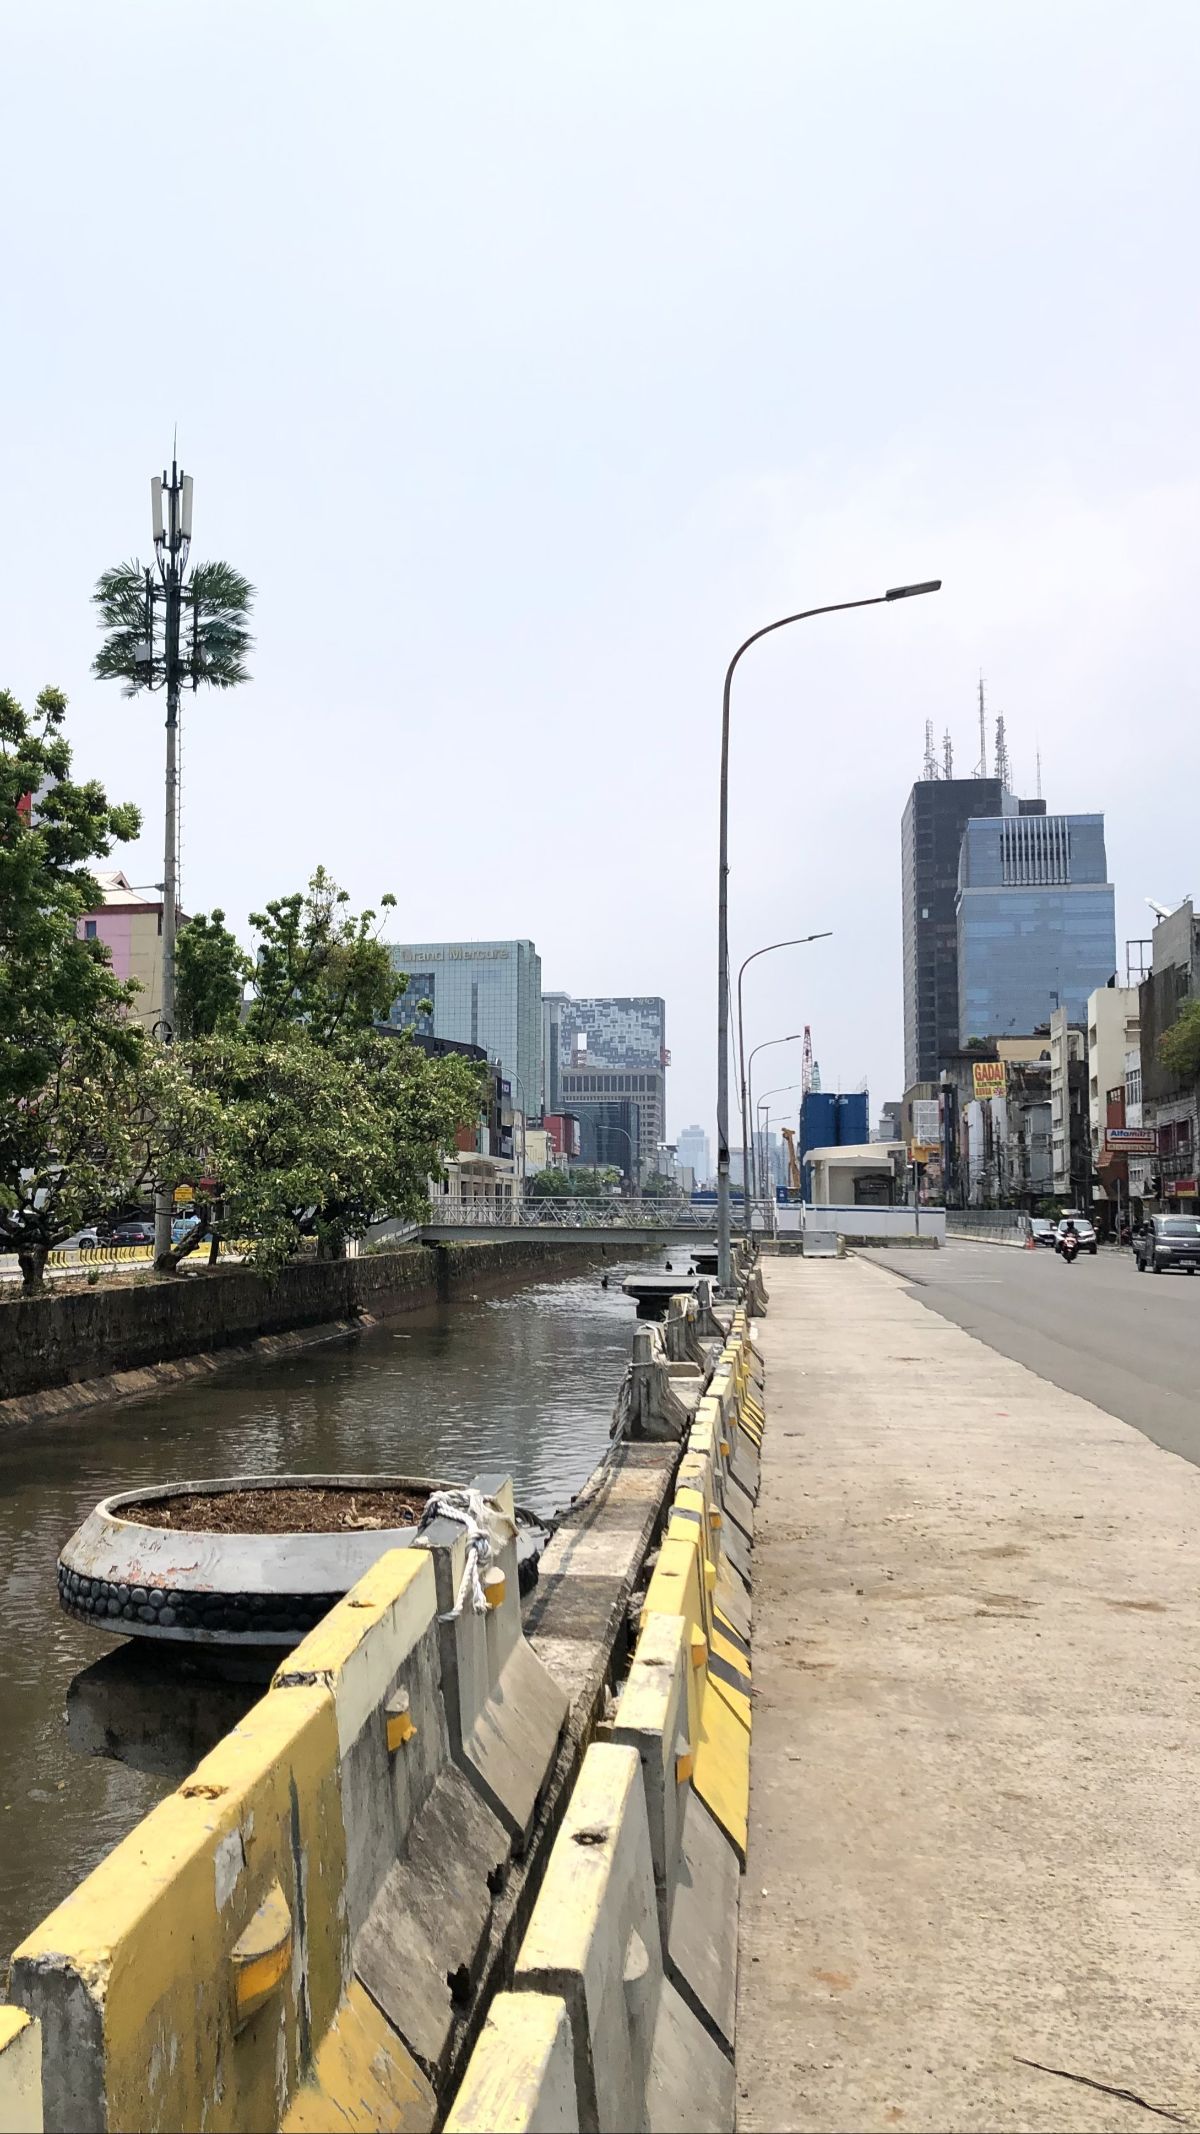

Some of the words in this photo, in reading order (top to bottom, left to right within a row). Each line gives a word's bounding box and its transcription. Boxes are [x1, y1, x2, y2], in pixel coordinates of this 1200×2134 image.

[401, 946, 445, 961] Grand
[448, 945, 509, 960] Mercure
[975, 1063, 1004, 1081] GADAI
